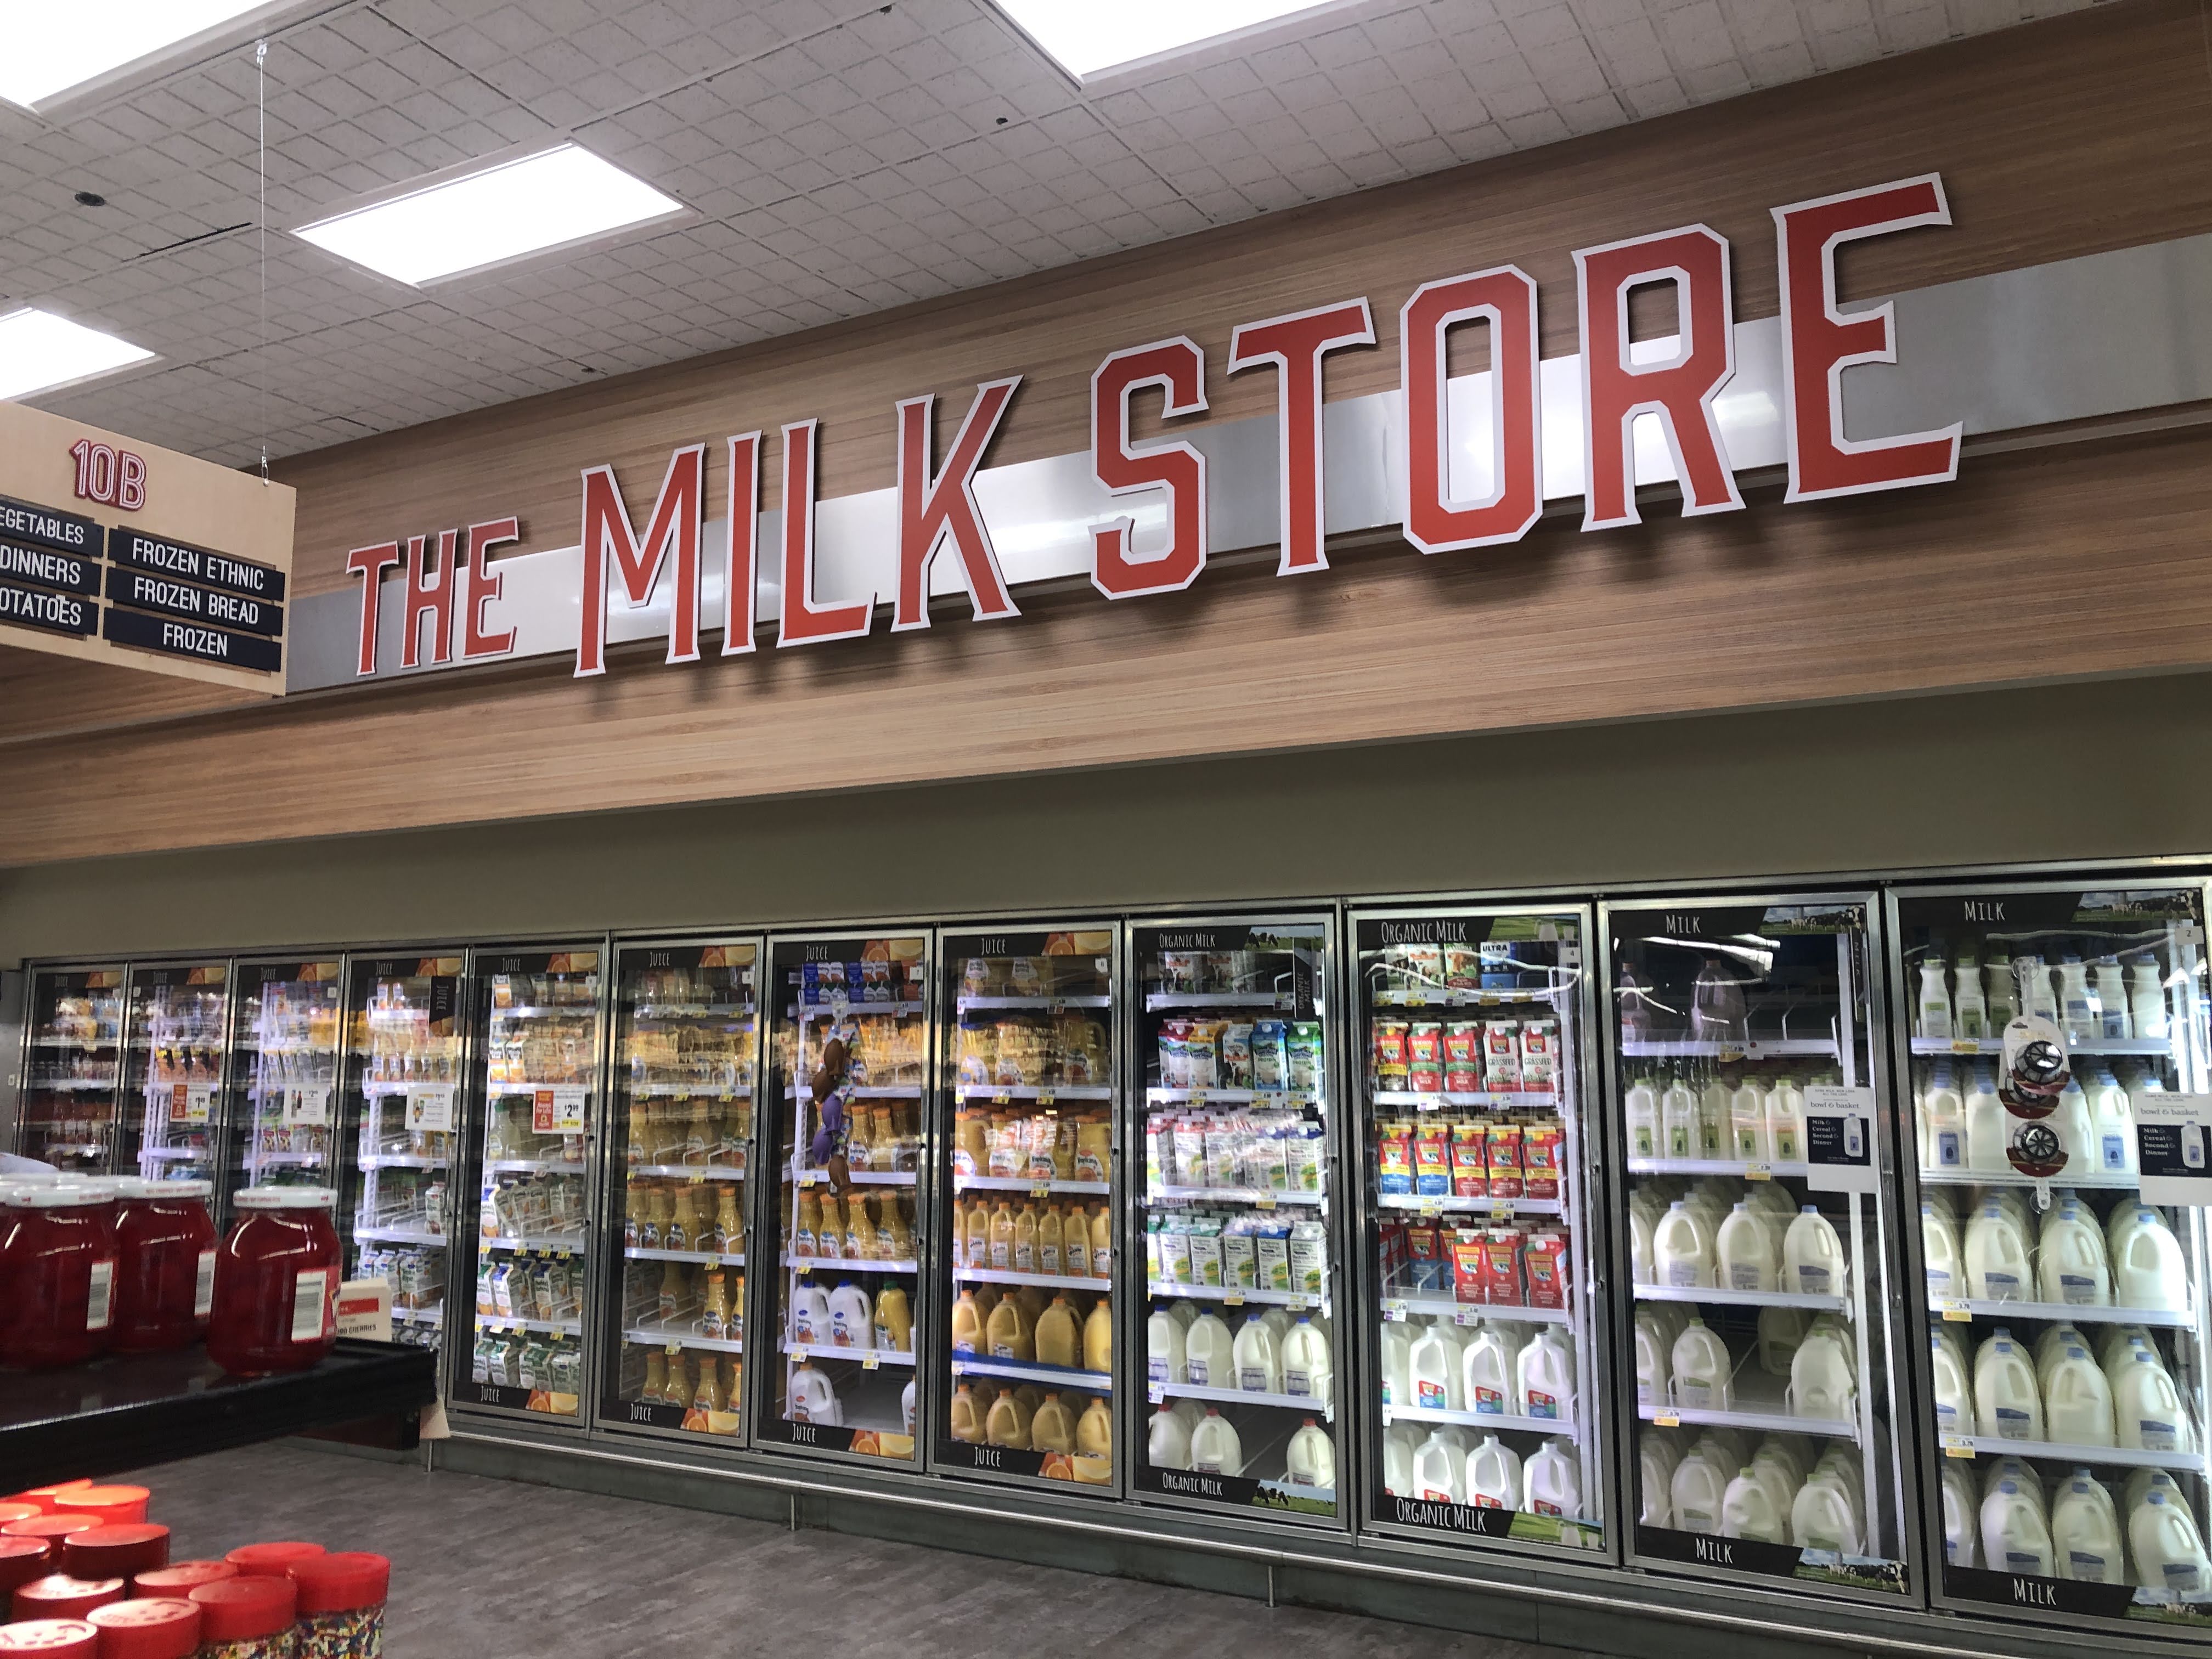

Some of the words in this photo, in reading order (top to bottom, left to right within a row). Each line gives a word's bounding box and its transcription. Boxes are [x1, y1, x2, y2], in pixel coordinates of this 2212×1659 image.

[346, 516, 520, 676] THE
[573, 374, 1024, 678] MILK
[1088, 173, 1963, 600] STORE
[69, 438, 146, 511] 10B
[0, 544, 81, 585] DINNERS
[132, 537, 199, 575] FROZEN
[206, 555, 264, 590] ETHNIC
[134, 576, 201, 613] FROZEN
[208, 601, 259, 625] BREAD
[163, 623, 228, 657] FROZEN
[1964, 900, 2006, 922] MILK
[1381, 921, 1434, 944] ORGANIC
[1436, 919, 1467, 942] MILK
[1666, 914, 1701, 934] MILK
[981, 937, 1006, 956] JUICE
[1159, 933, 1193, 949] ORGANIC
[1195, 933, 1216, 948] MILK
[649, 951, 670, 968] JUICE
[805, 944, 828, 962] JUICE
[375, 961, 393, 976] JUICE
[501, 957, 521, 973] JUICE
[480, 1385, 500, 1403] JUICE
[630, 1403, 652, 1422] JUICE
[792, 1423, 816, 1443] JUICE
[974, 1446, 1001, 1468] JUICE
[1163, 1472, 1199, 1493] ORGANIC
[1201, 1478, 1223, 1497] MILK
[1396, 1497, 1452, 1528] ORGANIC
[1454, 1504, 1487, 1532] MILK
[1695, 1537, 1733, 1564] MILK
[2013, 1578, 2057, 1606] MILK
